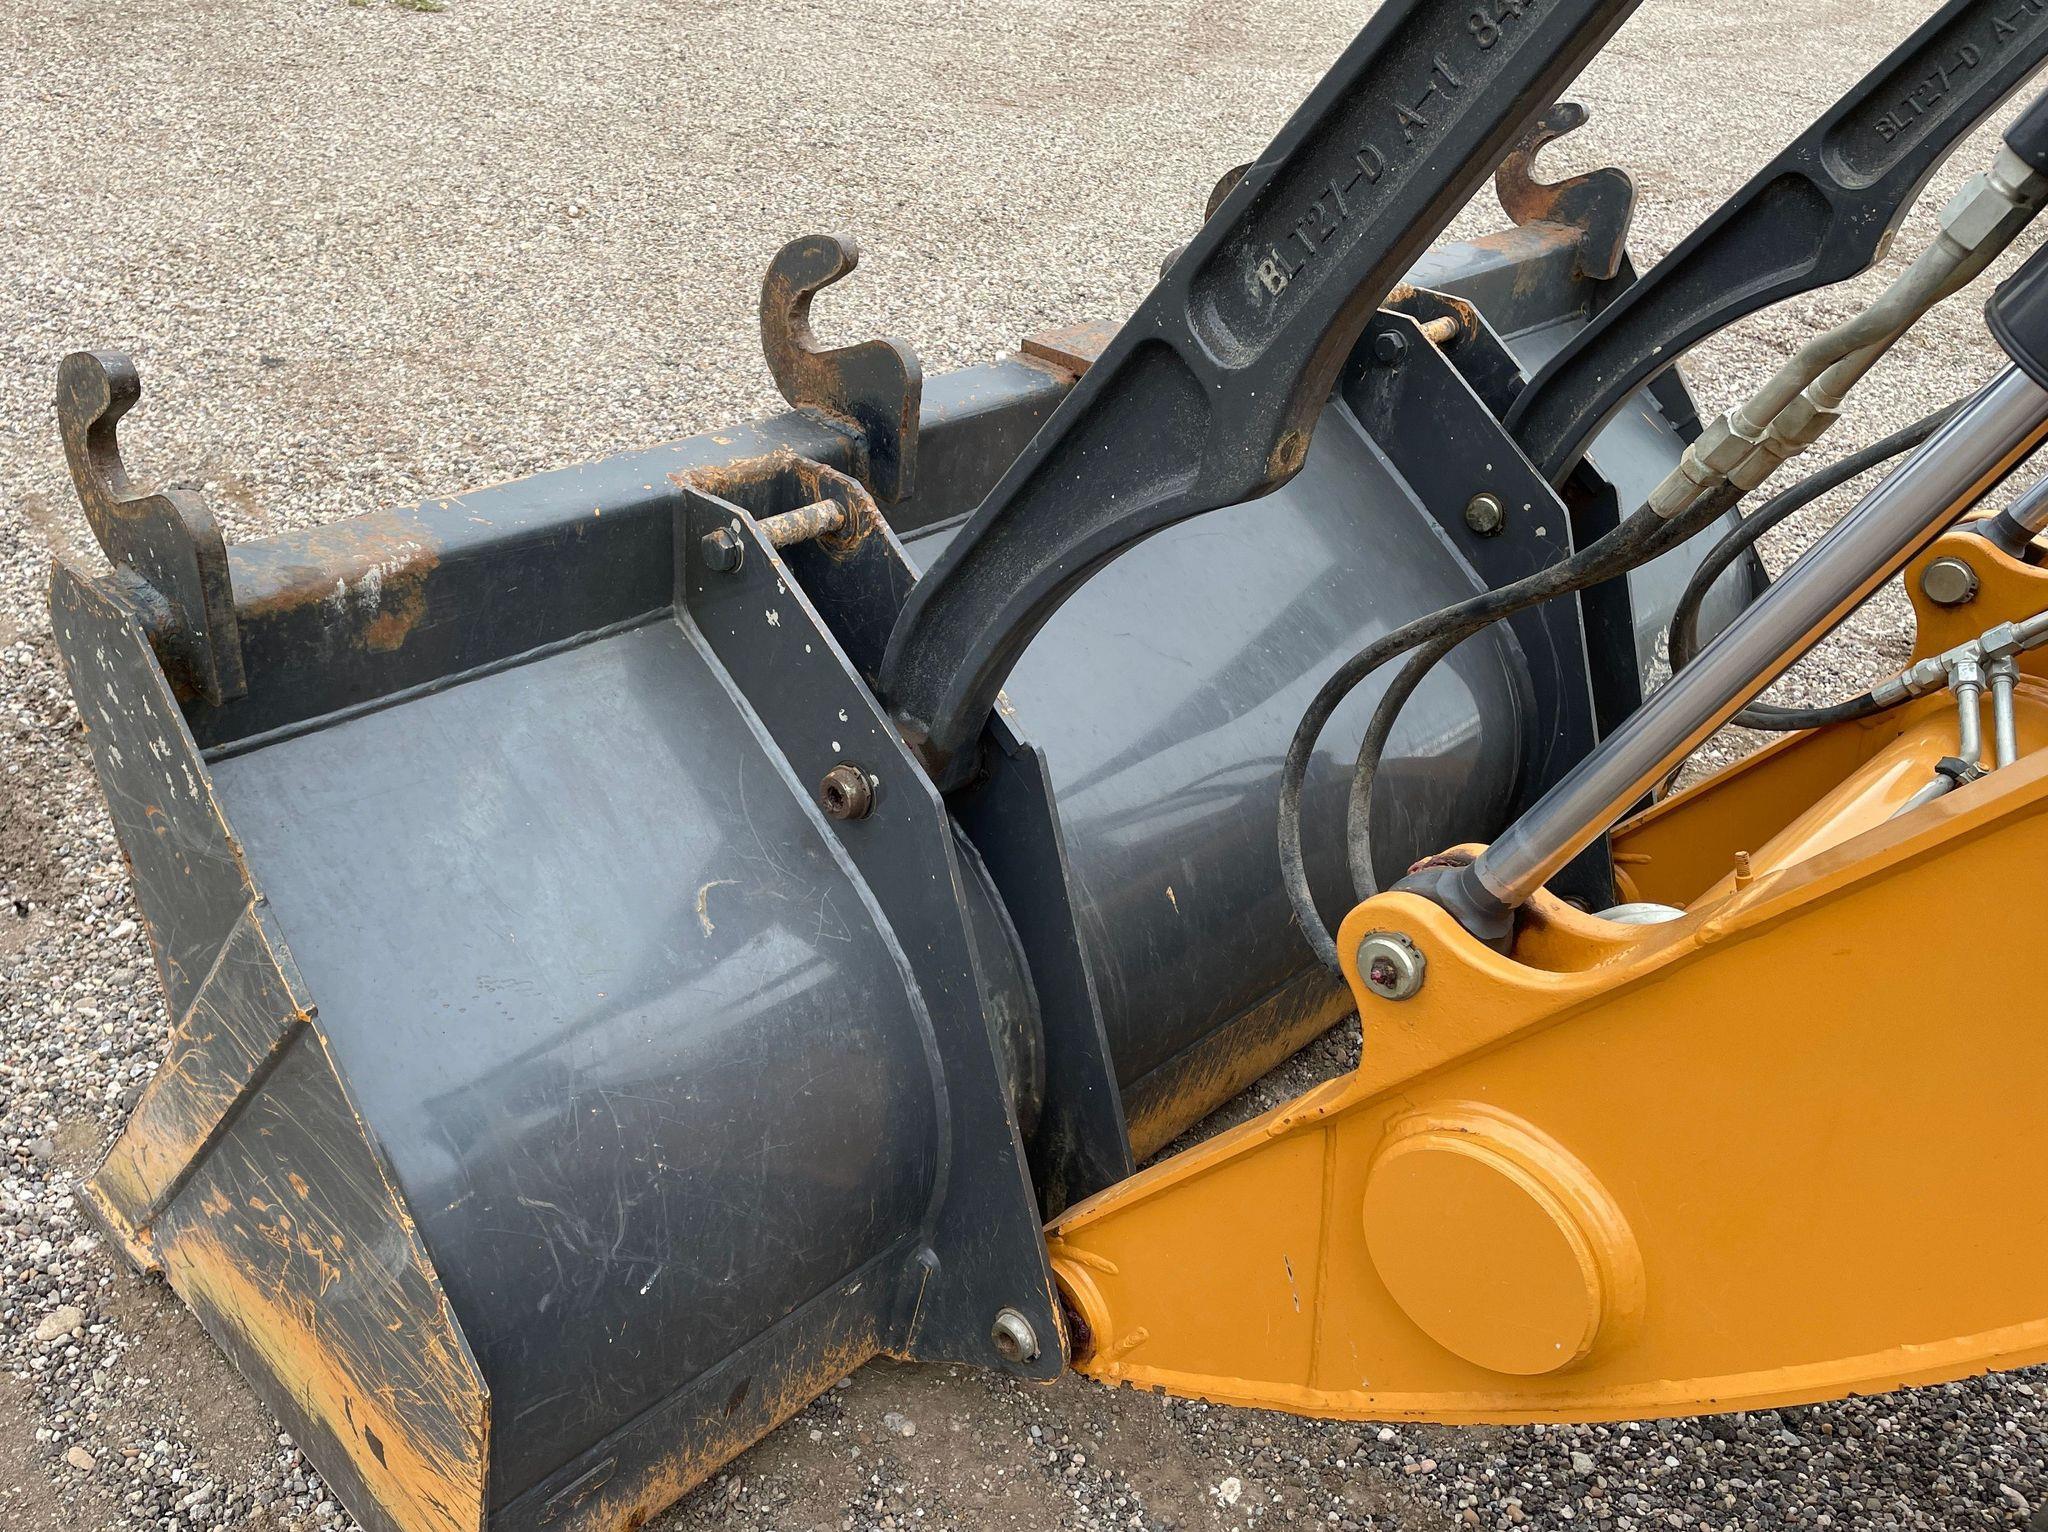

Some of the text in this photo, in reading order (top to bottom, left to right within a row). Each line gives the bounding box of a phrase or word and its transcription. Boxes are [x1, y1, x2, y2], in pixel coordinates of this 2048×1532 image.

[1256, 144, 1386, 297] BLT27-D
[1393, 54, 1463, 144] A-1
[1873, 43, 1981, 144] BLT27-D
